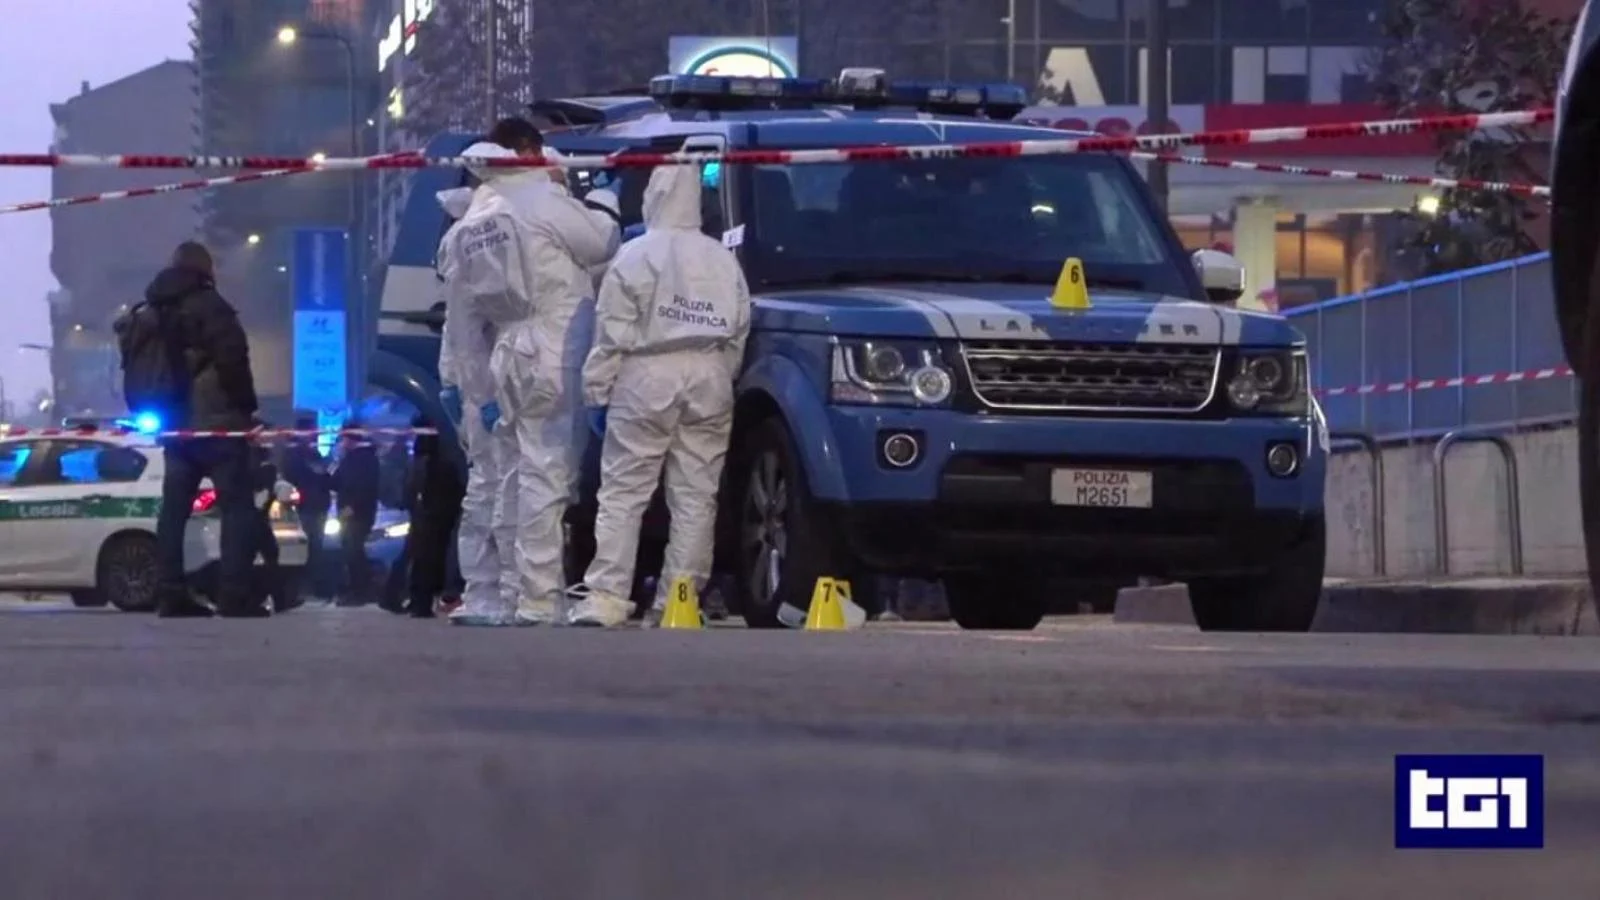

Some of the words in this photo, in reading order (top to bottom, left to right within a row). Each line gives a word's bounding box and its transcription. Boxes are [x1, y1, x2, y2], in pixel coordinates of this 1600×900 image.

[1070, 264, 1080, 284] 6
[673, 294, 714, 313] POLIZIA
[657, 304, 727, 328] SCIENTIFICA
[1073, 471, 1130, 485] POLIZIA
[1076, 486, 1128, 506] M2651
[678, 582, 688, 603] 8
[822, 583, 832, 603] 7
